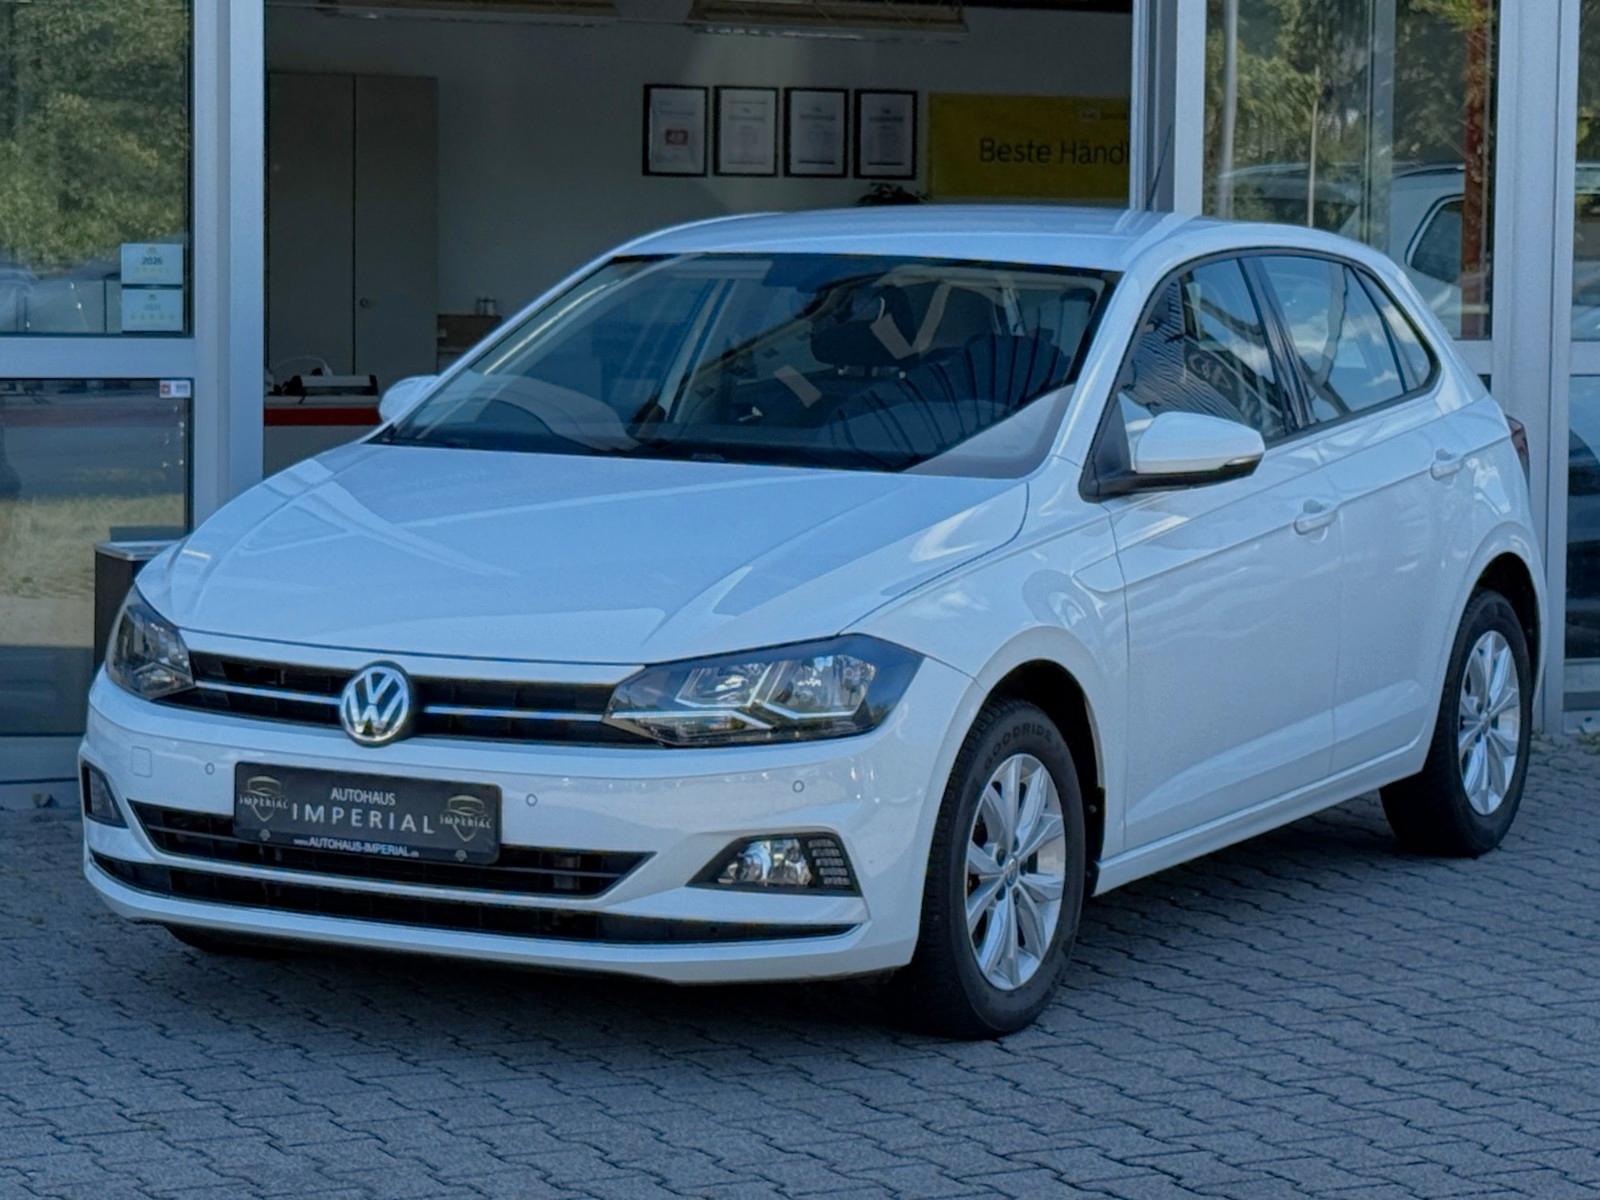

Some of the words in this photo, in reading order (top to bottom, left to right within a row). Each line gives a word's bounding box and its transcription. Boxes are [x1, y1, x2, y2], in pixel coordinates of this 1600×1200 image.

[979, 138, 1050, 163] Beste
[239, 794, 288, 809] IMPERIAL
[330, 787, 396, 806] AUTOHAUS
[292, 803, 435, 834] IMPERIAL
[440, 814, 492, 829] IMPERIAL
